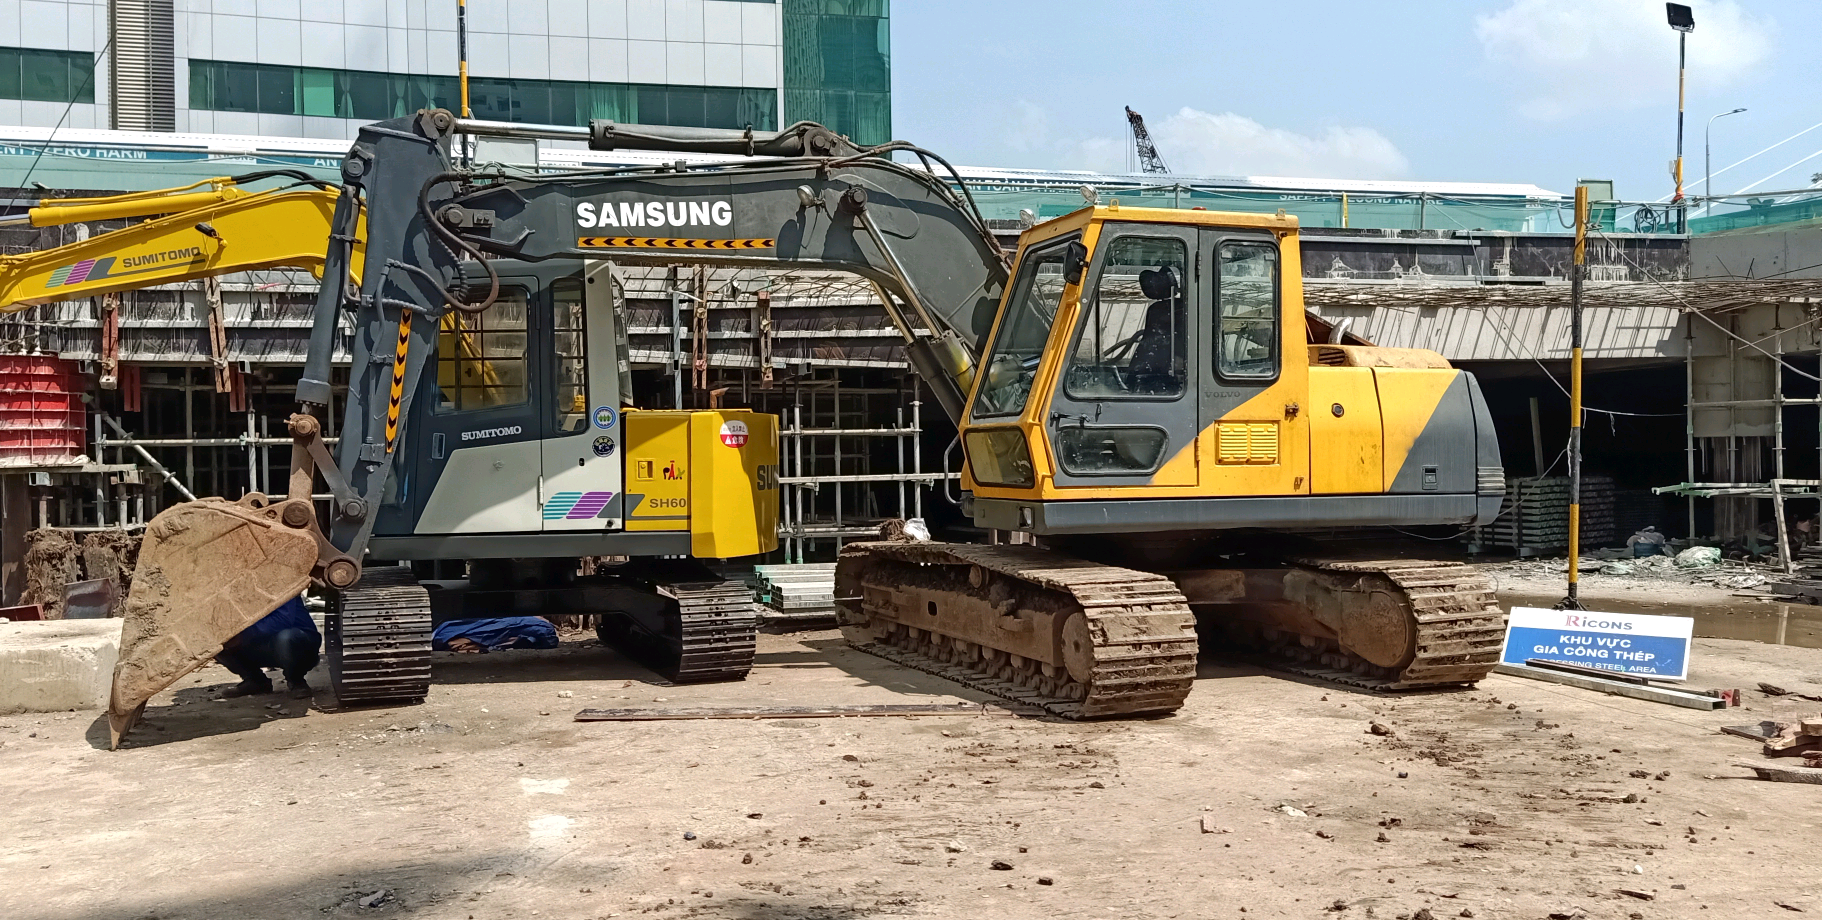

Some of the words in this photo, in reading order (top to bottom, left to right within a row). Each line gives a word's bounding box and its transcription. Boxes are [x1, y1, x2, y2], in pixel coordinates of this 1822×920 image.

[95, 148, 147, 159] HARM
[314, 159, 338, 167] AN
[1394, 197, 1444, 205] NATRE
[576, 201, 732, 228] SAMSUNG
[123, 246, 201, 268] SUMITOMO
[461, 425, 522, 441] SUMITOMO
[649, 497, 687, 508] SH60
[1559, 635, 1593, 645] KHU
[1597, 637, 1631, 649] VỰC
[1533, 644, 1559, 655] GIA
[1563, 645, 1609, 658] CÔNG
[1613, 650, 1655, 662] THÉP
[1628, 665, 1657, 674] AREA
